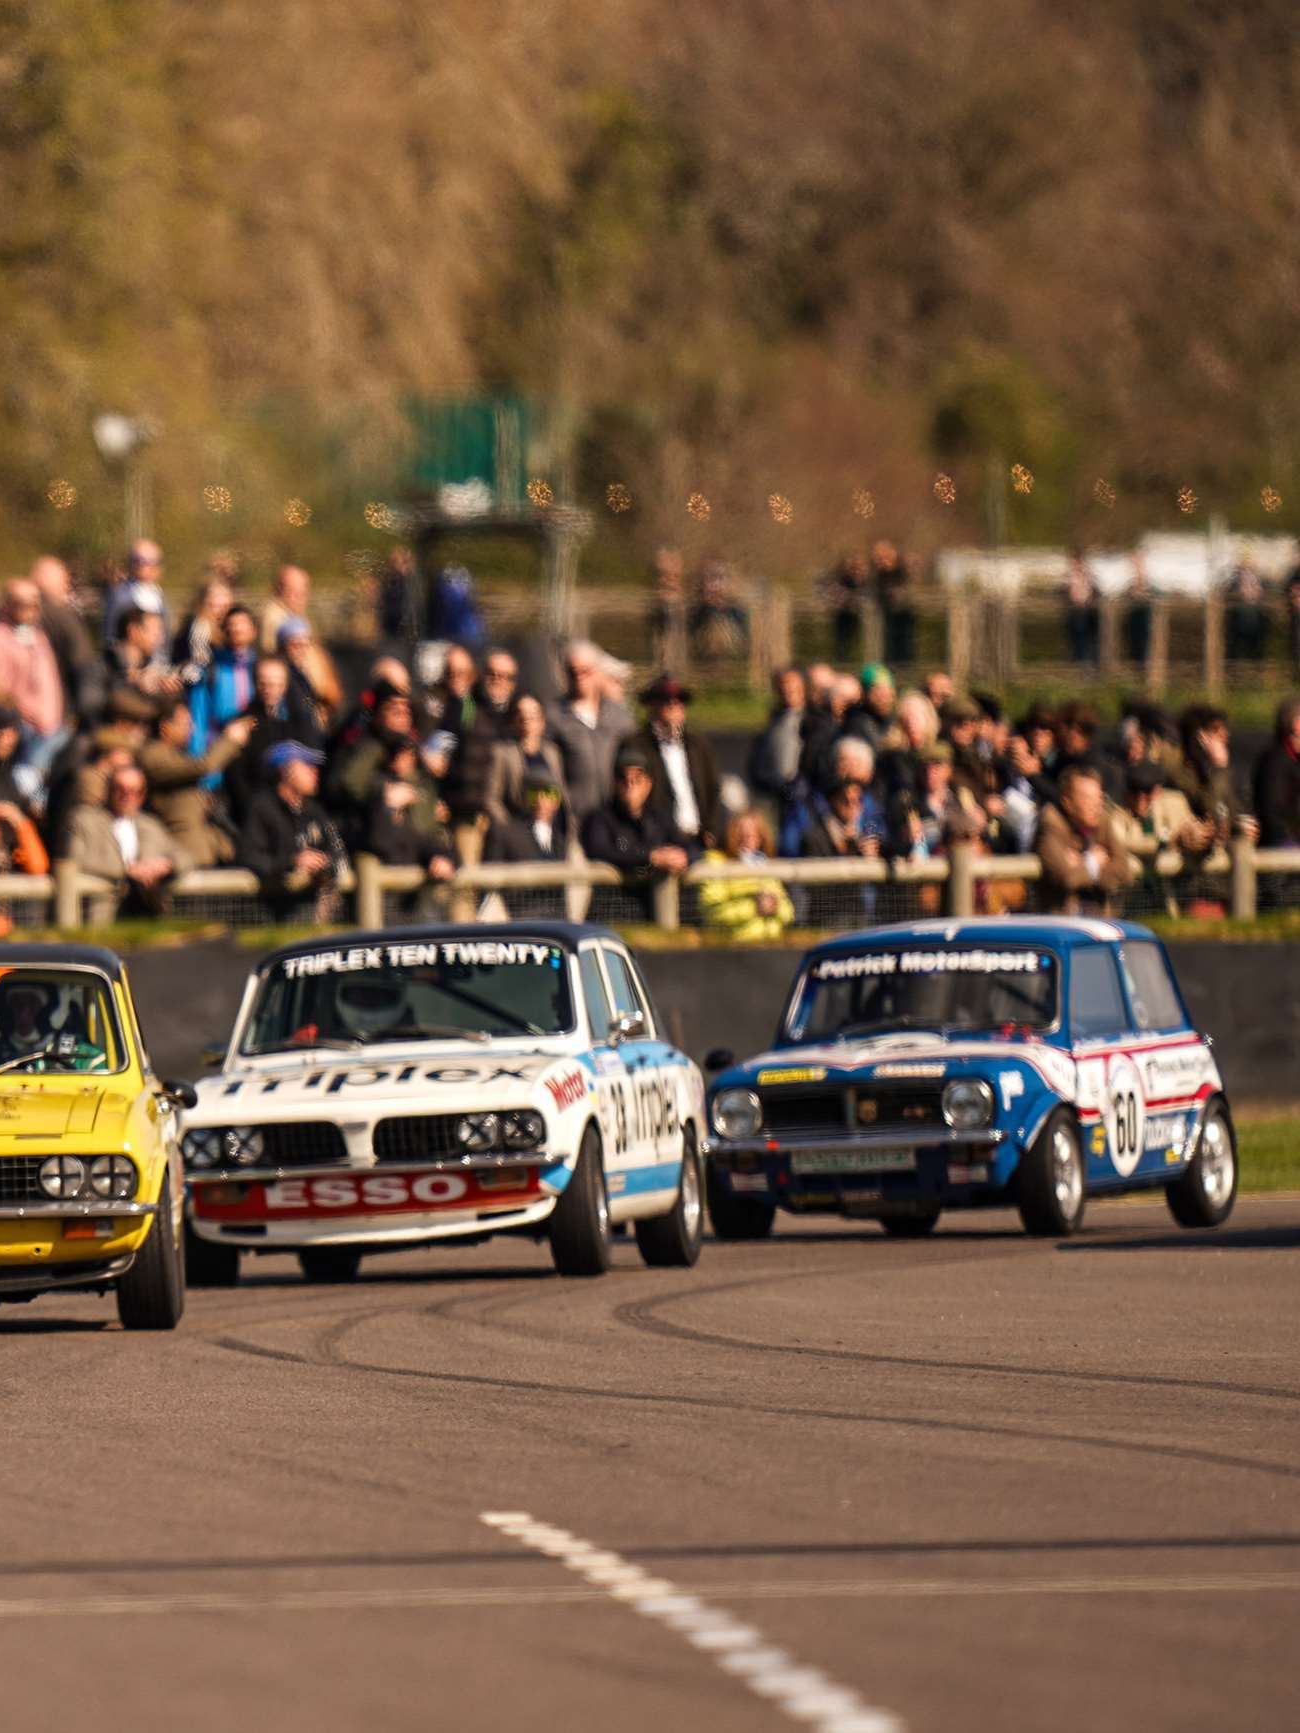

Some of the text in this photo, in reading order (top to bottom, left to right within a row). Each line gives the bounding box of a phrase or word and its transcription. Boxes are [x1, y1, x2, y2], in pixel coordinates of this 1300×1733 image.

[284, 942, 549, 979] TRIPLEX TEN TWENTY
[1115, 1091, 1137, 1153] 60
[265, 1173, 467, 1208] ESSO
